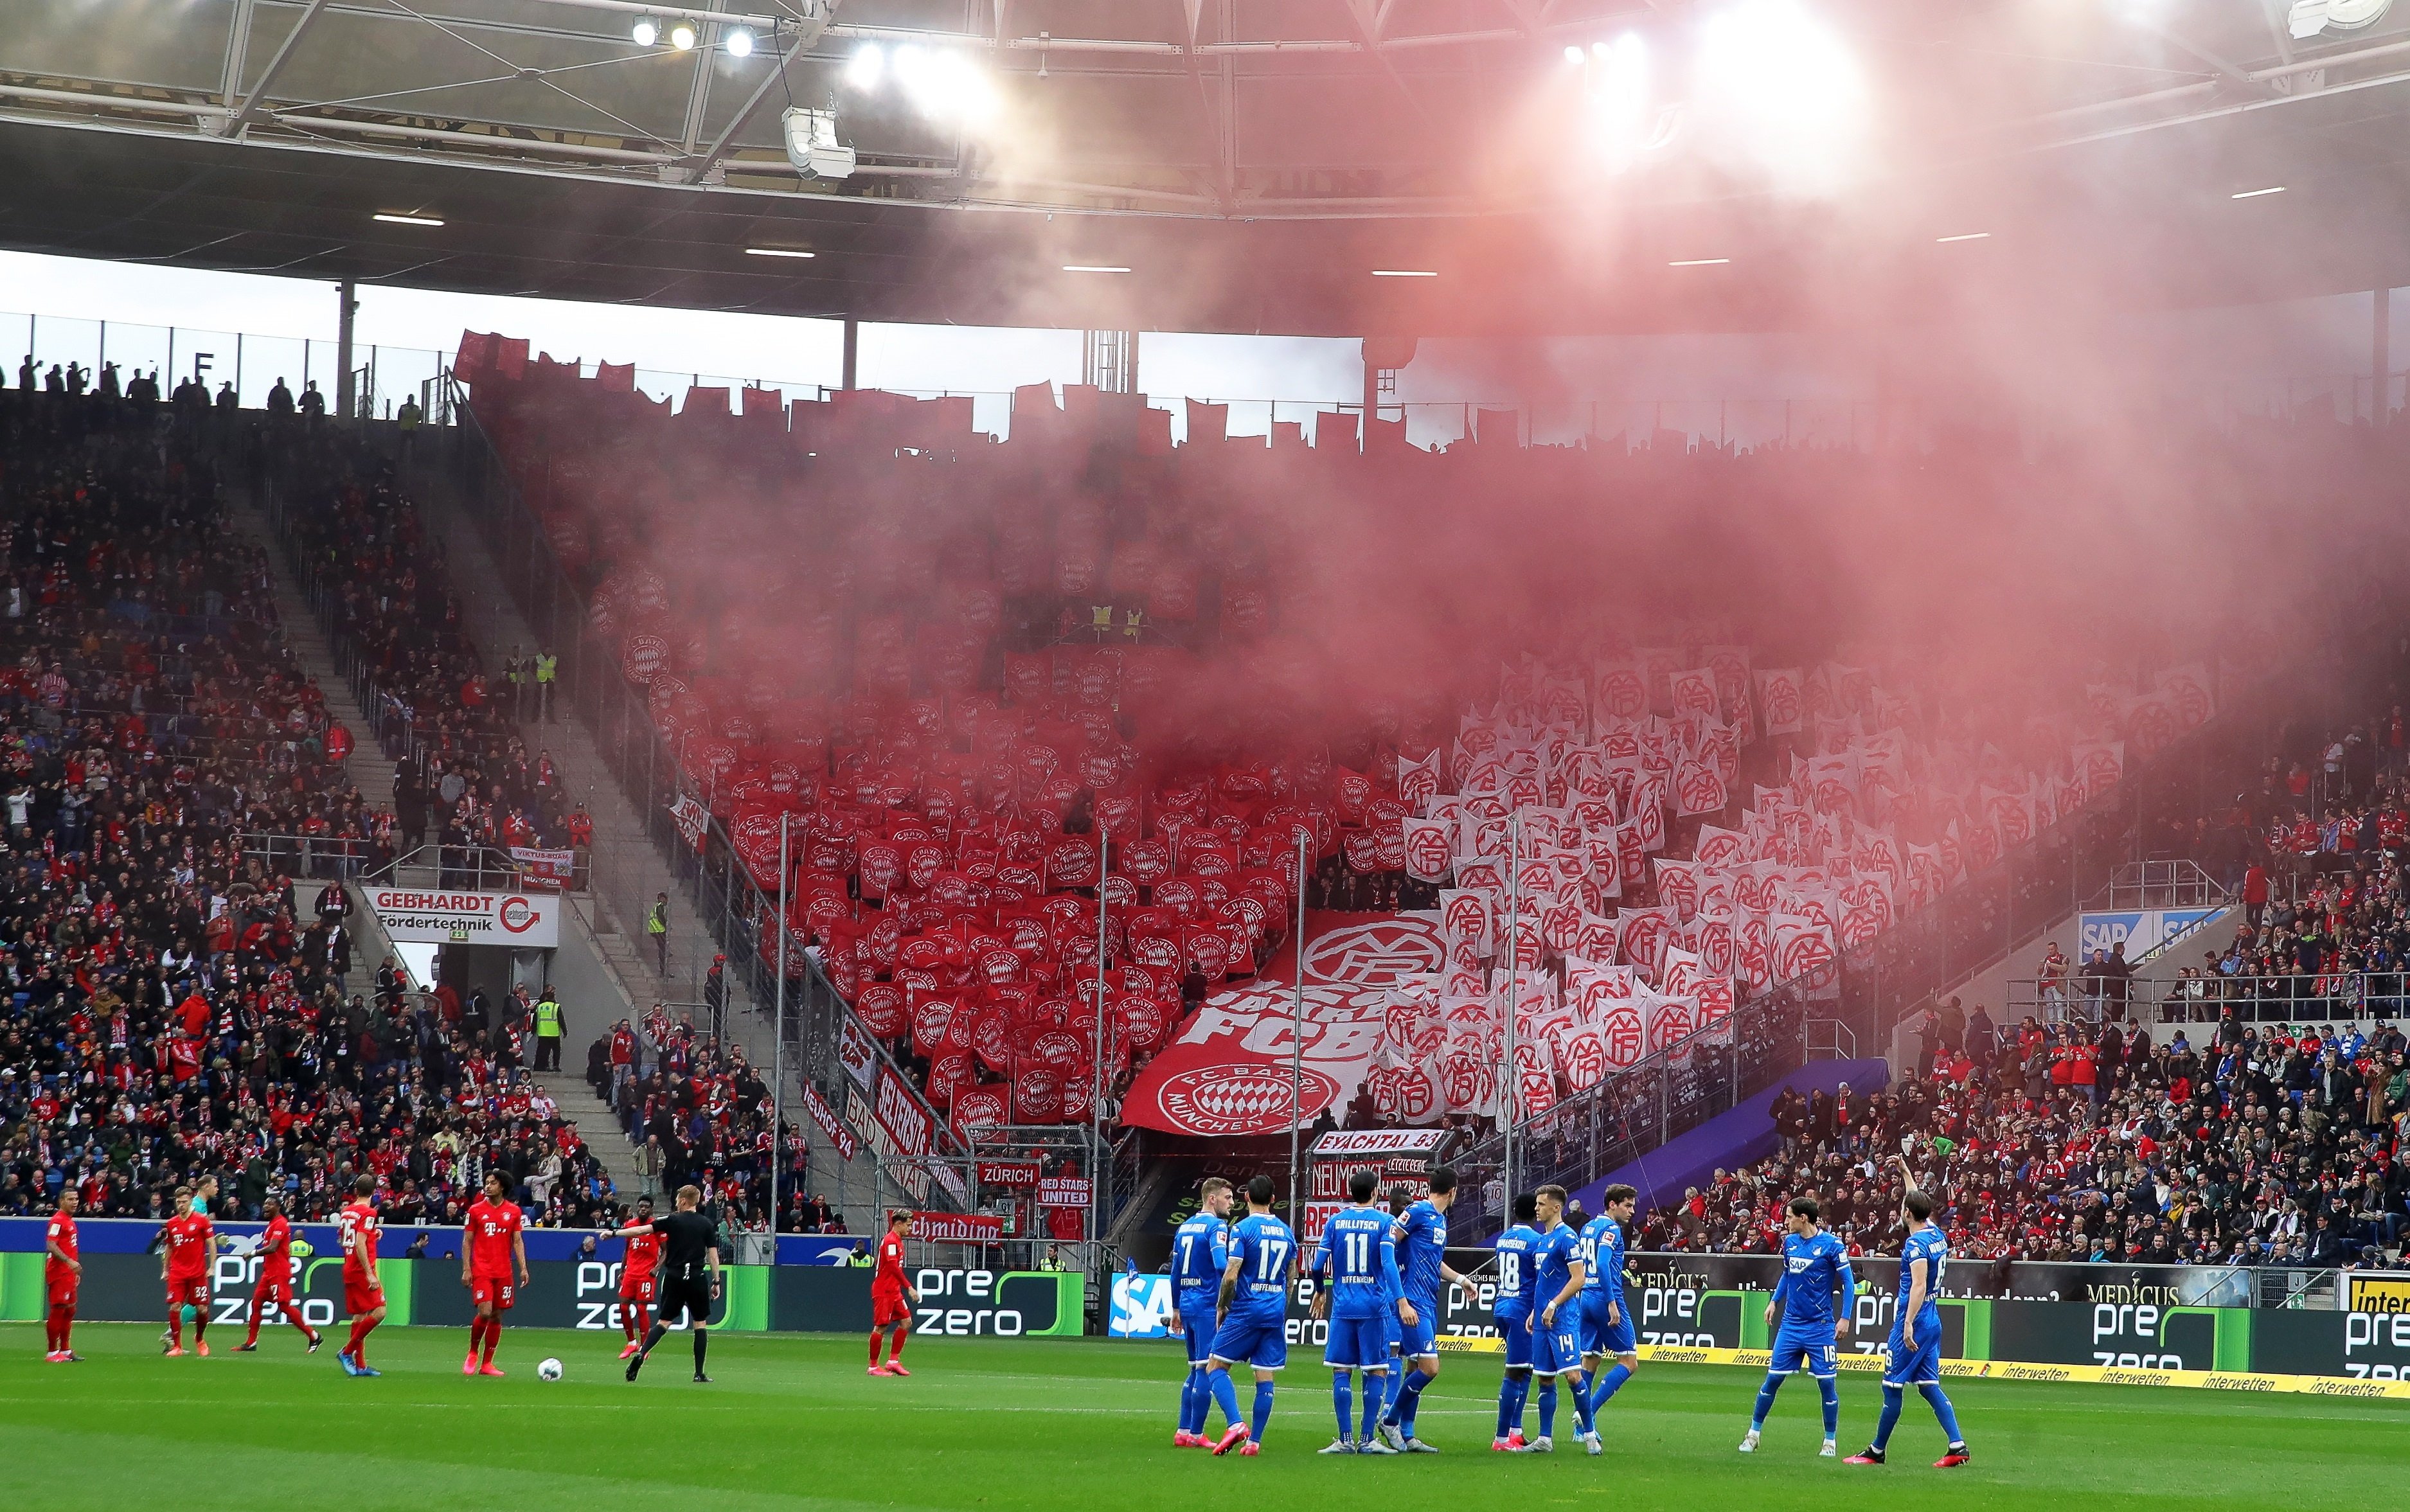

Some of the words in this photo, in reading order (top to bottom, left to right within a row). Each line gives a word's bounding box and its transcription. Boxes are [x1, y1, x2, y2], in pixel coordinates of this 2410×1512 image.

[377, 892, 494, 912] GEBHARDT
[379, 915, 493, 931] Fördertechnik
[2083, 923, 2128, 955] SAP
[1175, 1006, 1383, 1060] FCB
[846, 1095, 876, 1145] BAD
[1167, 1092, 1263, 1132] MÜNCHEN
[984, 1166, 1034, 1183] ZÜRICH
[1040, 1178, 1058, 1189] RED
[1060, 1178, 1089, 1191] STARS
[1042, 1191, 1088, 1204] UNITED
[1260, 1224, 1285, 1236] ZUBER
[1335, 1220, 1380, 1230] GRILLITSCH
[1181, 1236, 1193, 1275] 7
[1258, 1239, 1289, 1281] 17
[1344, 1232, 1368, 1272] 11
[1499, 1252, 1519, 1291] 18
[1790, 1260, 1806, 1270] SAP
[195, 1286, 208, 1298] 32
[641, 1282, 651, 1293] 19
[916, 1268, 994, 1303] pre
[1447, 1283, 1496, 1319] pre
[1643, 1288, 1697, 1326] pre
[916, 1308, 1022, 1336] zero
[1285, 1317, 1329, 1346] ero
[2093, 1303, 2159, 1346] pre
[1558, 1333, 1573, 1353] 14
[2345, 1312, 2410, 1356] pre
[1650, 1344, 1708, 1364] interwetten
[1823, 1345, 1836, 1363] 16
[1885, 1349, 1893, 1367] 6
[2002, 1363, 2070, 1382] interwetten
[2100, 1367, 2170, 1386] interwetten
[2202, 1373, 2275, 1391] interwetten
[2309, 1377, 2386, 1397] interwetten
